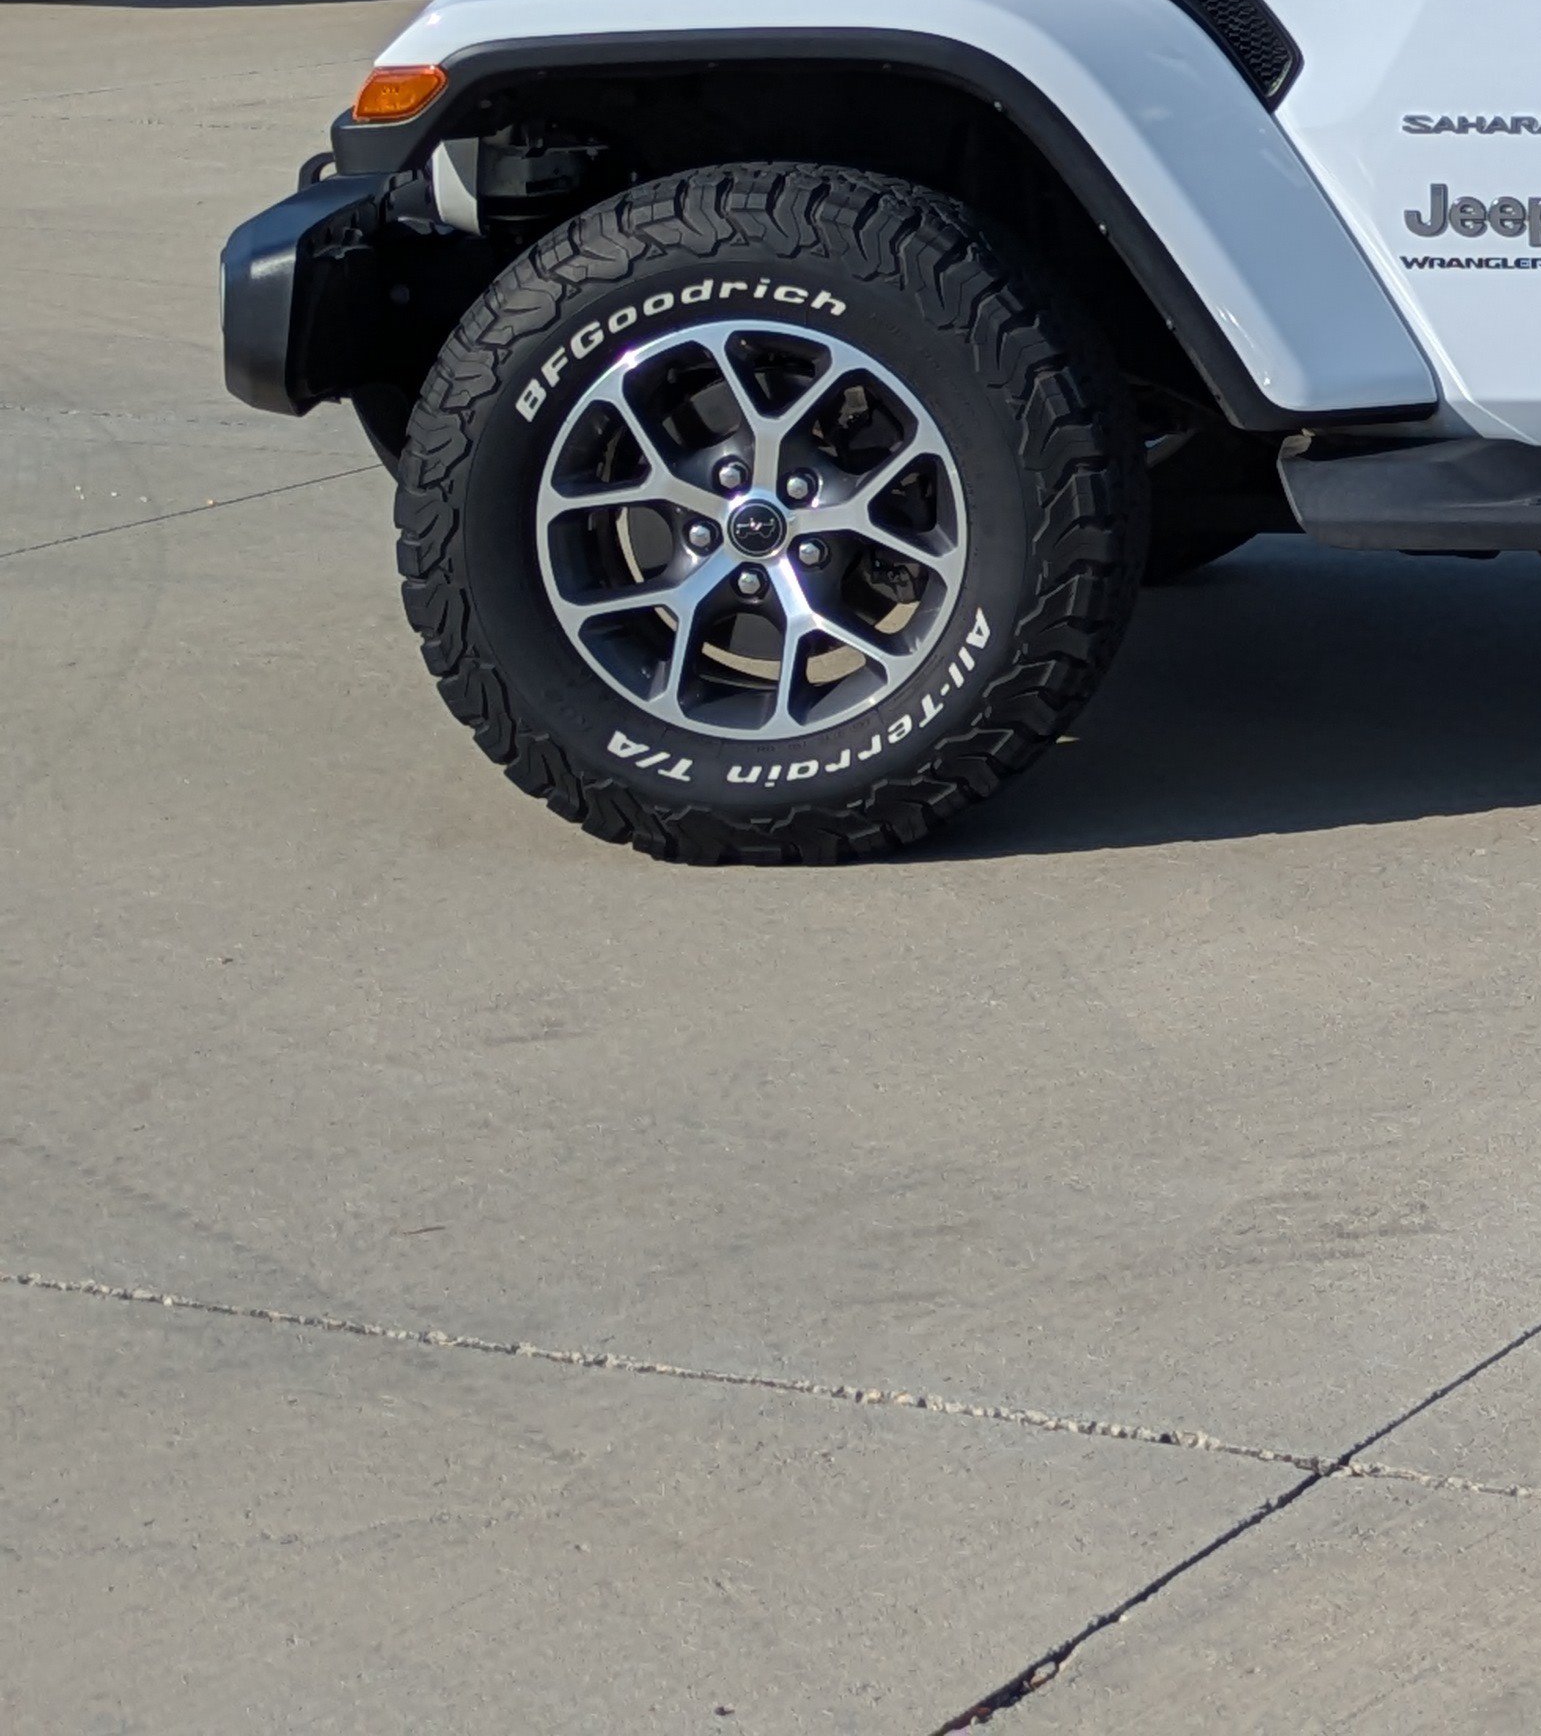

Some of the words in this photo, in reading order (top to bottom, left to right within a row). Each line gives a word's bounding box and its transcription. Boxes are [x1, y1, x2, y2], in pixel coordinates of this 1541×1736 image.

[514, 277, 848, 423] BFGoodrich
[606, 730, 696, 783] T/A
[726, 607, 992, 788] All-Terrain
